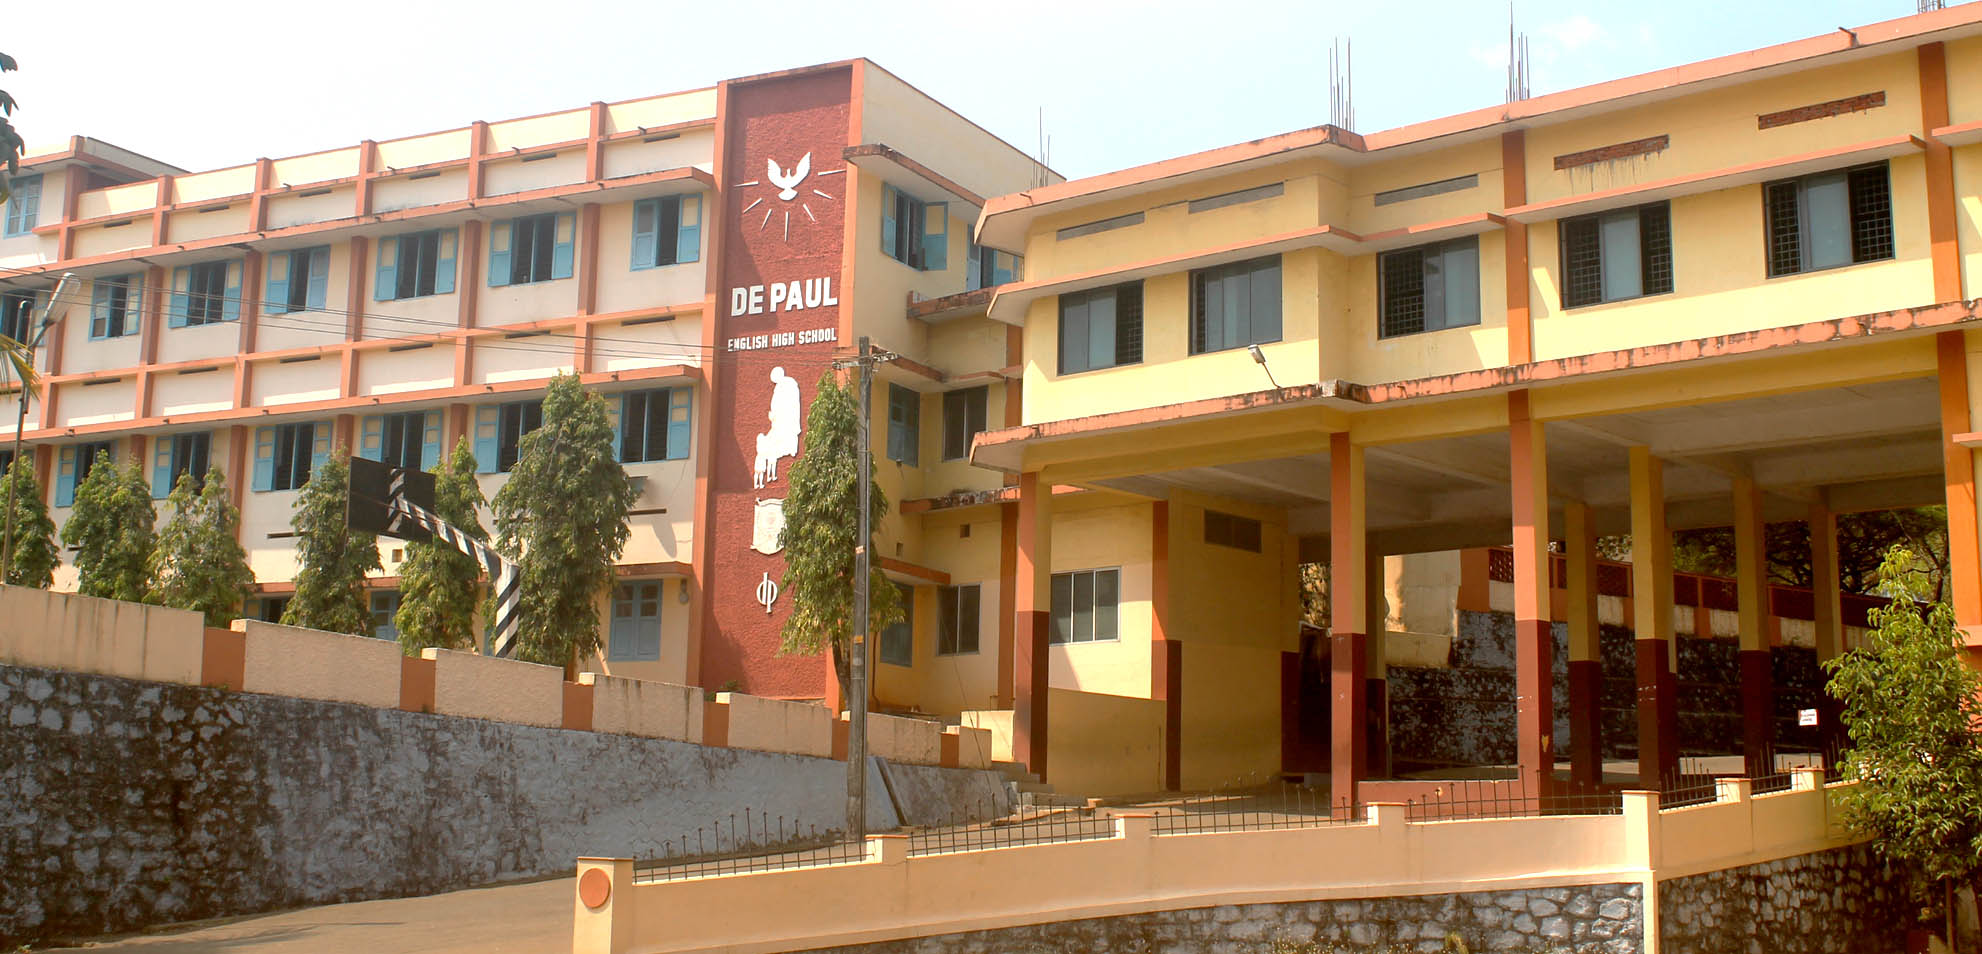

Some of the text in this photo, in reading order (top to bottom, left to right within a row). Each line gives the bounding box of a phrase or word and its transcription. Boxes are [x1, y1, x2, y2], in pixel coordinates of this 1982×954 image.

[731, 276, 838, 317] DE PAUL
[727, 327, 838, 352] ENGLISH HIGH SCHOOL
